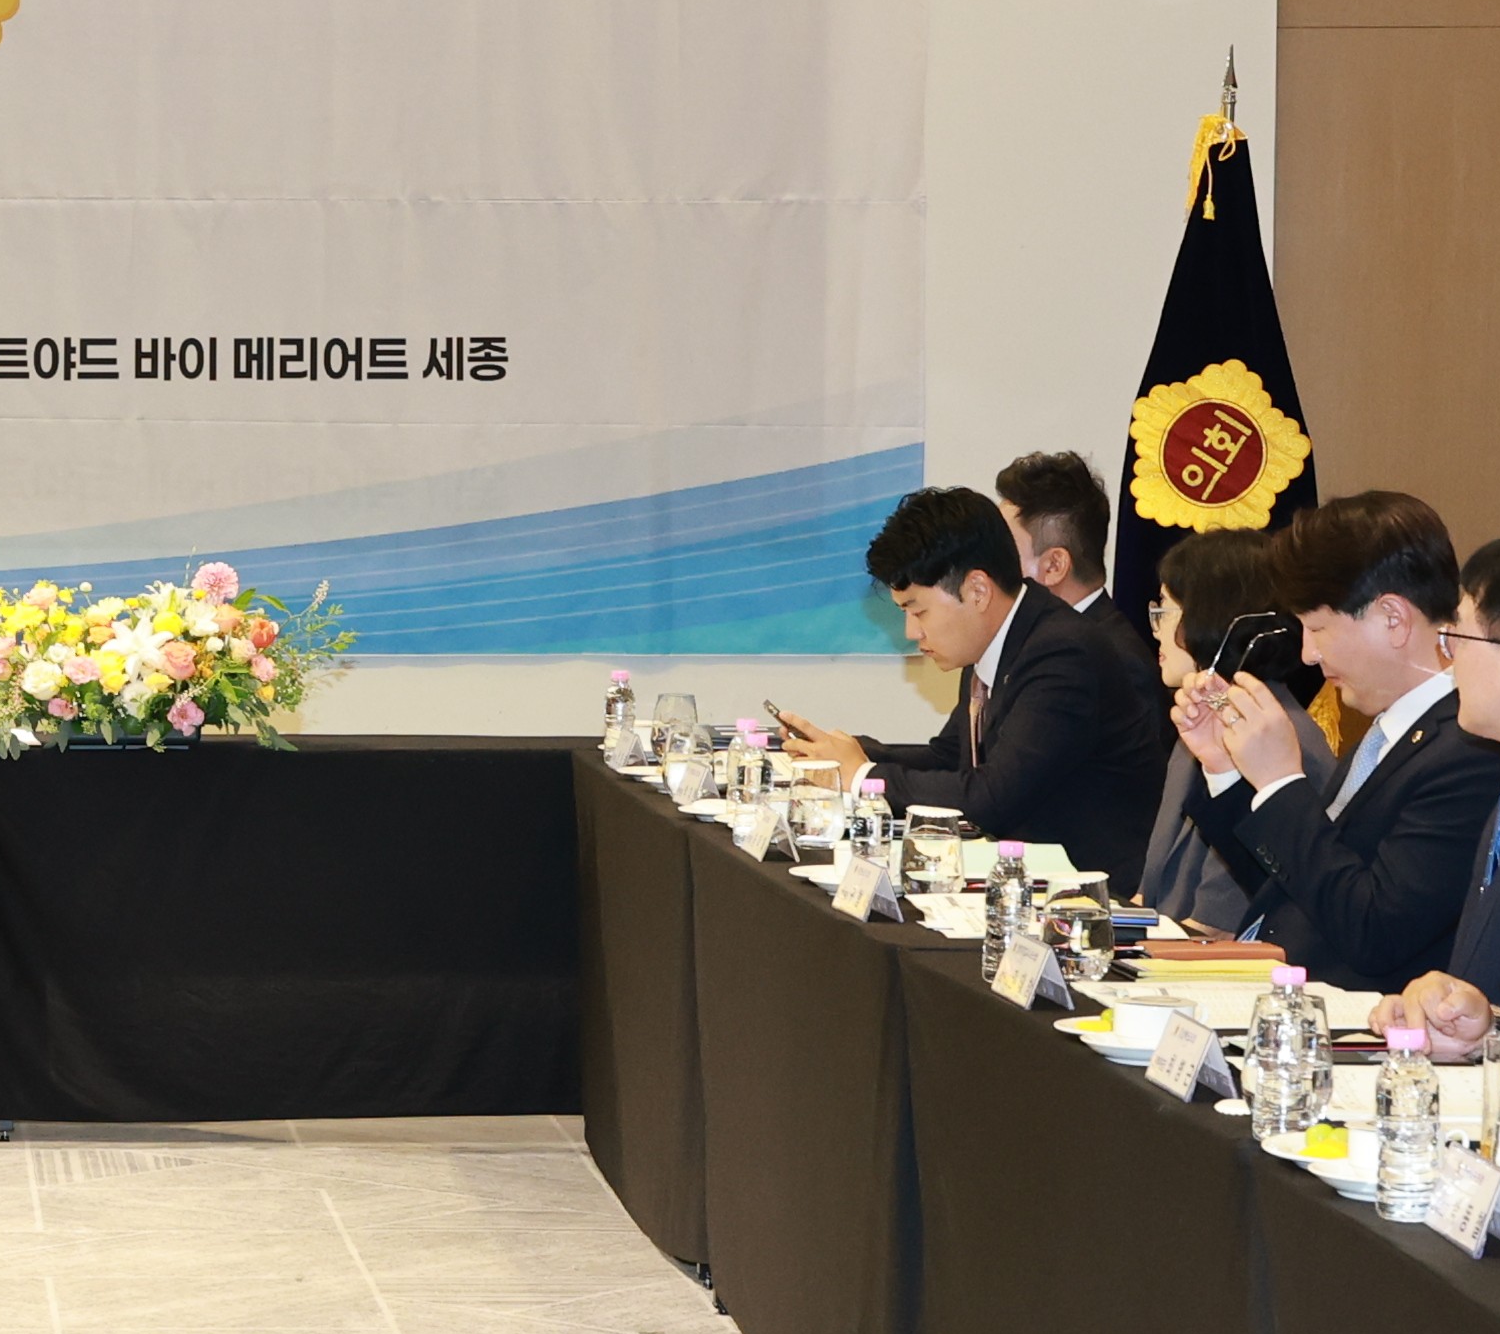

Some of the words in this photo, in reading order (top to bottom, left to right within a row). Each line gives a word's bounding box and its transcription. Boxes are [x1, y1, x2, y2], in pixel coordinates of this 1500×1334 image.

[134, 336, 217, 381] 바이
[233, 336, 409, 382] 메리어트
[422, 336, 509, 382] 세종
[1181, 409, 1253, 501] 의회
